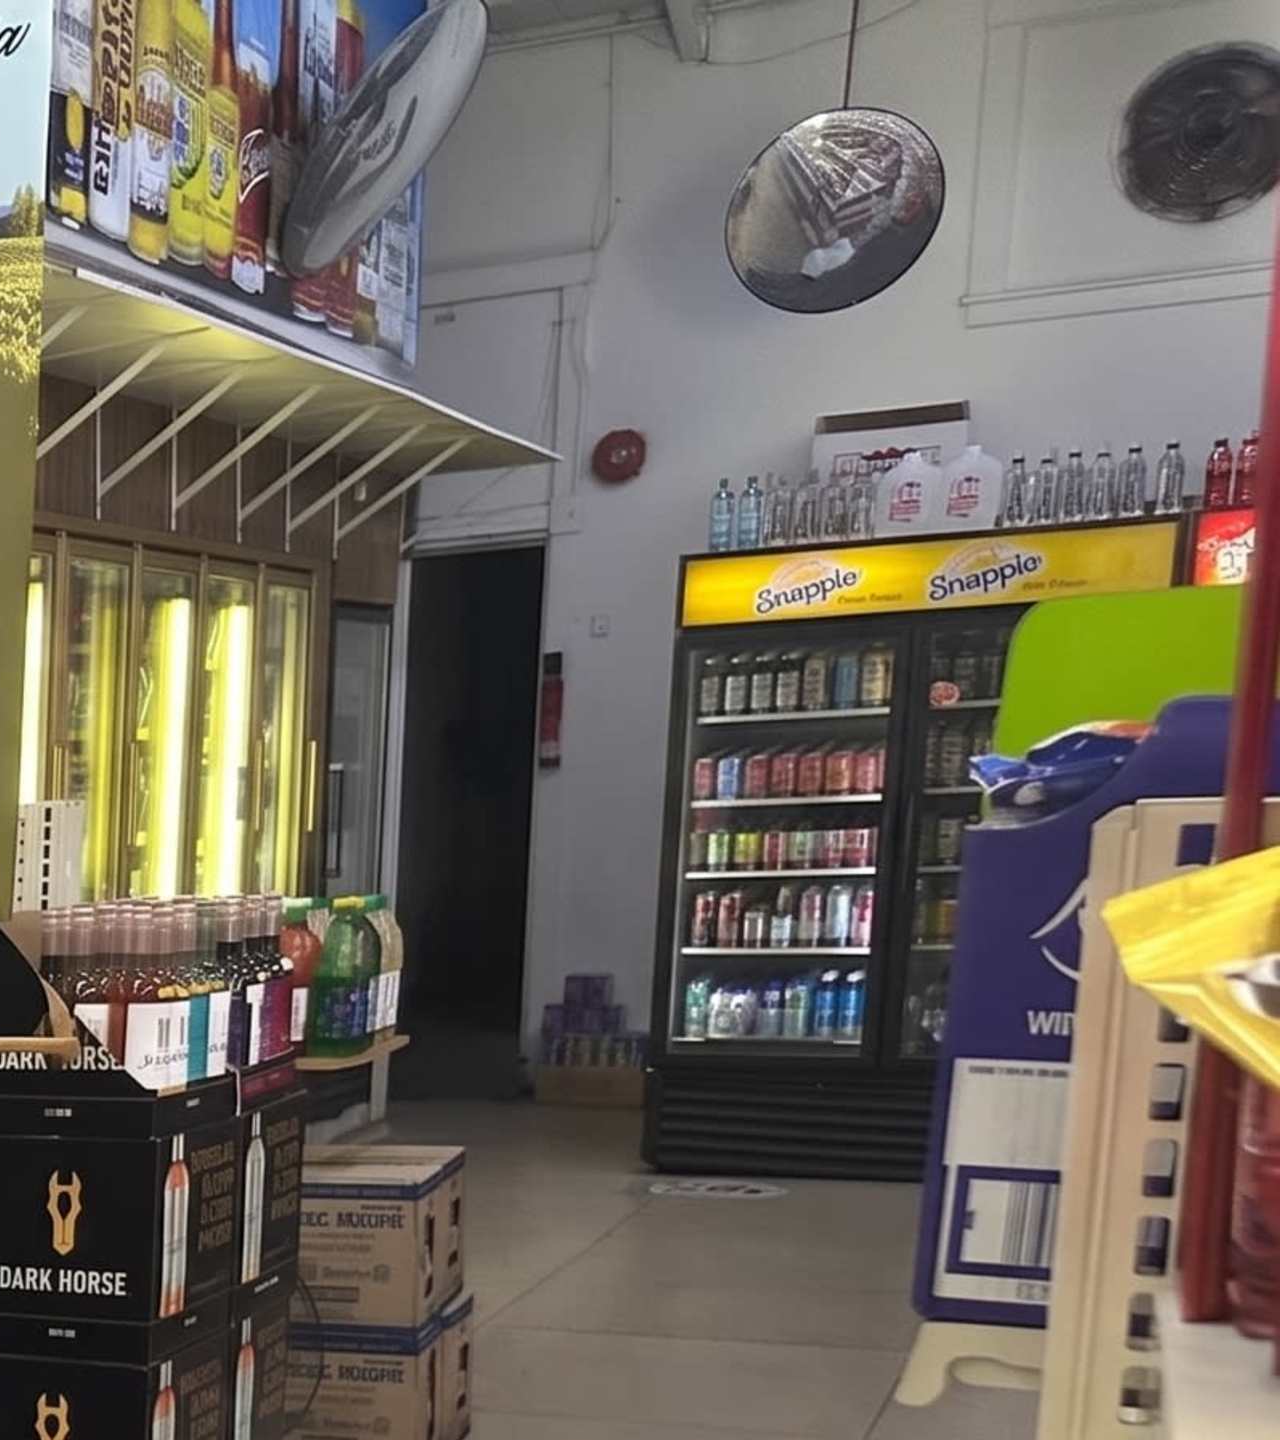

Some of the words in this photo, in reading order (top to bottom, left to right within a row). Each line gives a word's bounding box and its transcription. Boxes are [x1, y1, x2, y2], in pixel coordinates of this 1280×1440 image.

[755, 568, 859, 616] Snapple
[929, 552, 1042, 601] Snapple
[0, 1265, 53, 1291] DARK
[58, 1268, 128, 1296] HORSE
